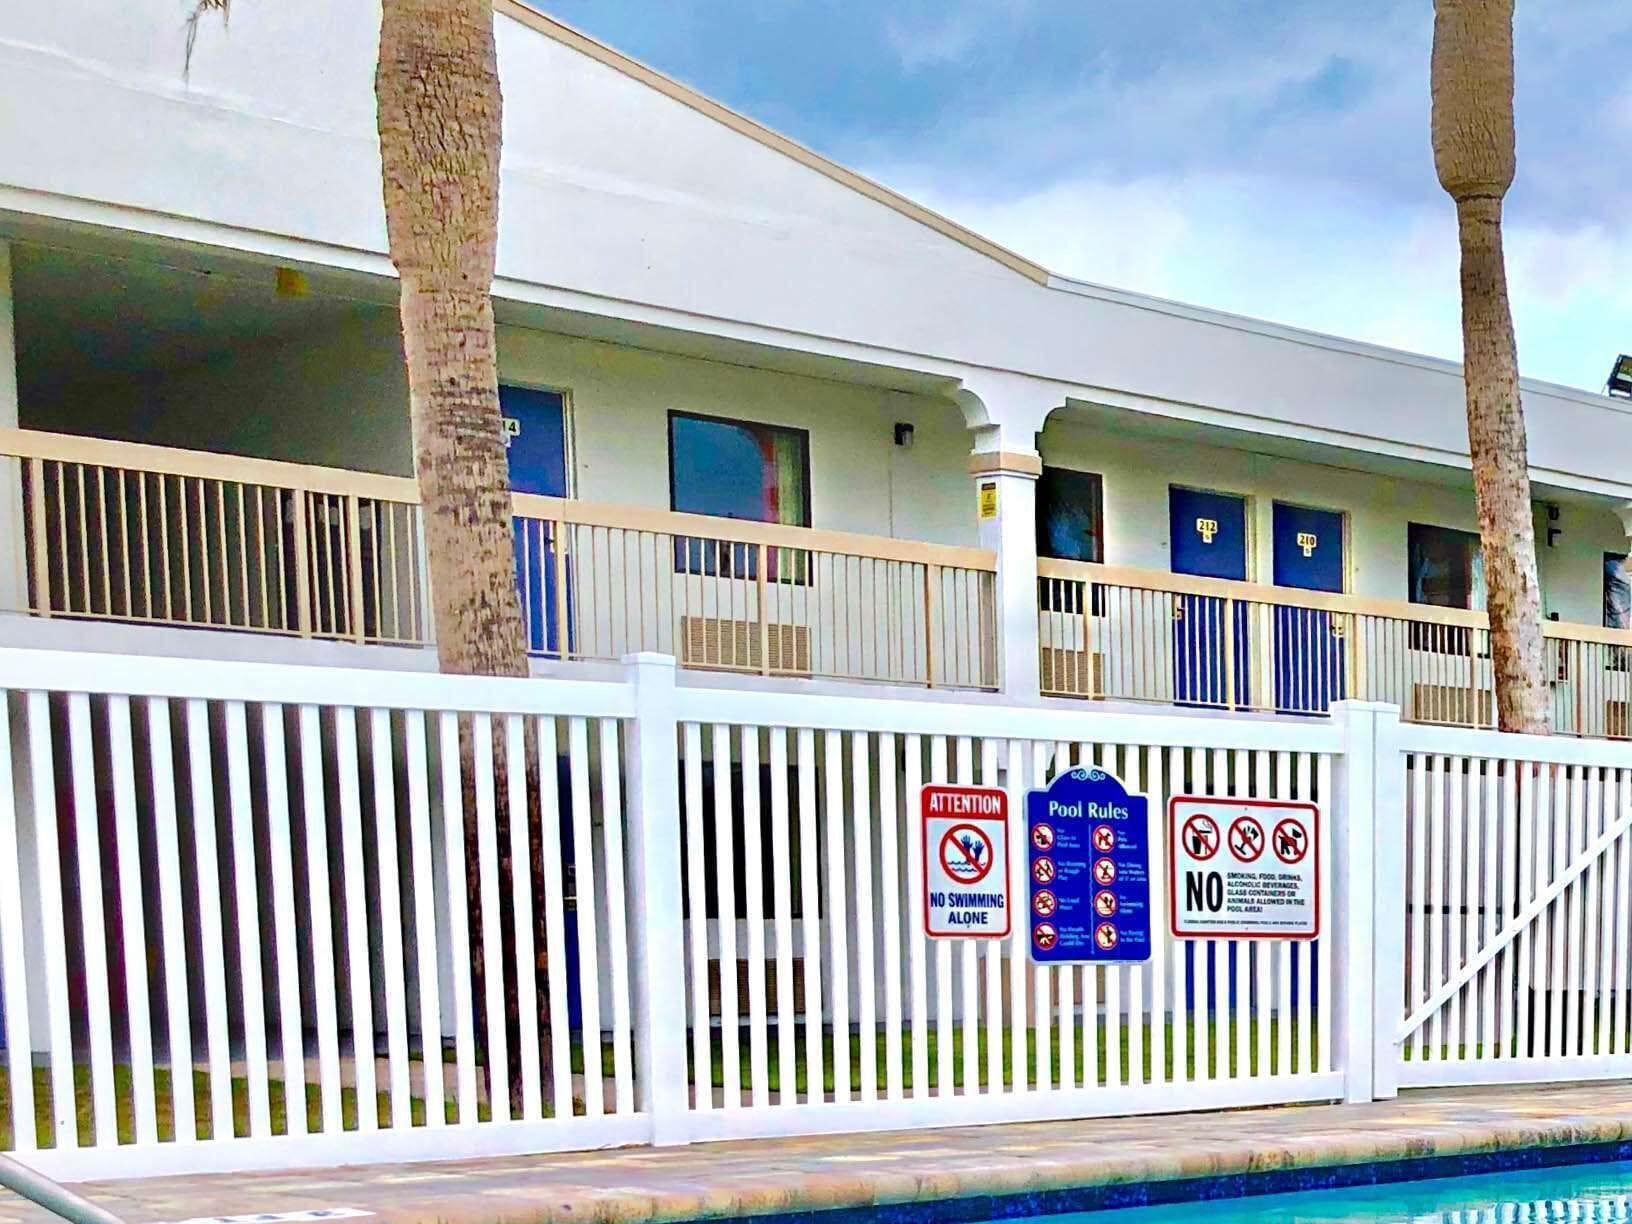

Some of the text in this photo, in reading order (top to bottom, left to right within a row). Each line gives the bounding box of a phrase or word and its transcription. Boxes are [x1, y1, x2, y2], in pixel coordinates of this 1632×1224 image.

[1199, 520, 1216, 532] 212
[1299, 534, 1315, 546] 210
[929, 792, 1001, 815] ATTENTION
[1049, 800, 1129, 820] Pool Rules
[1227, 872, 1257, 880] SMOKING,
[1278, 874, 1303, 882] DRINKS,
[1186, 871, 1224, 913] NO
[930, 892, 1004, 909] NO SWIMMING
[948, 911, 988, 925] ALONE
